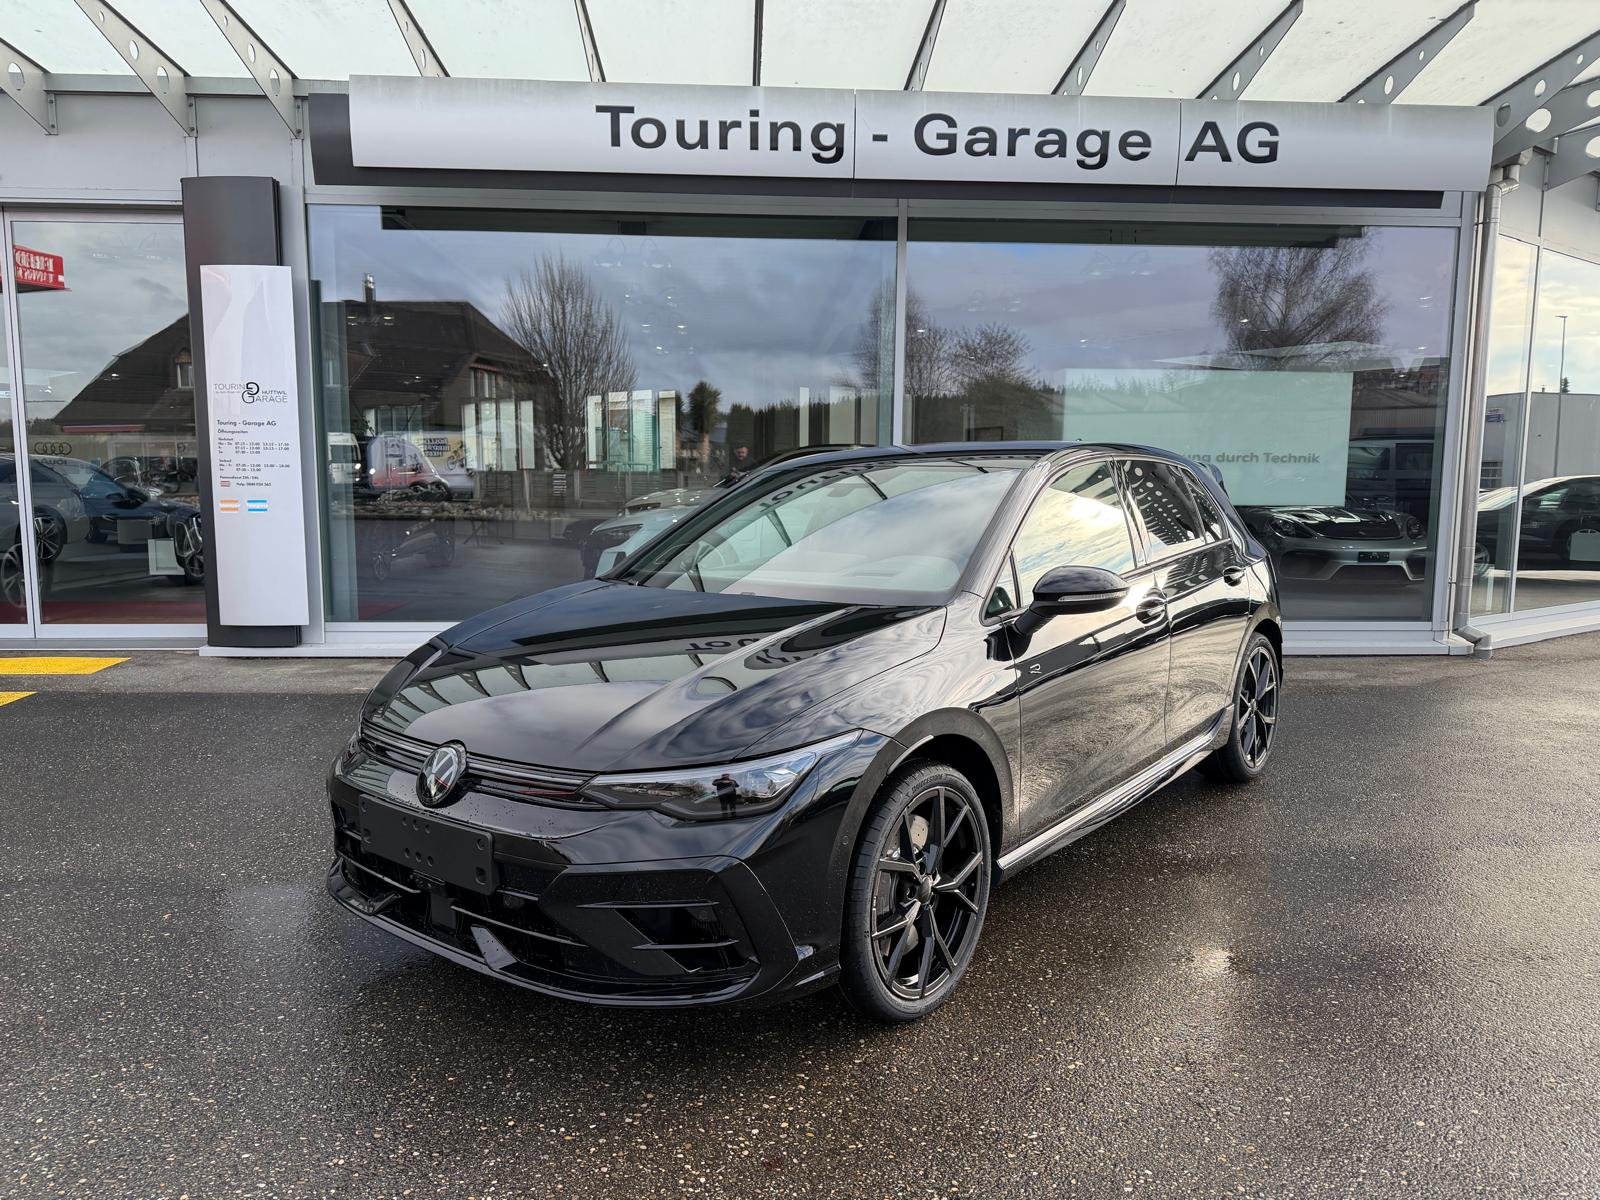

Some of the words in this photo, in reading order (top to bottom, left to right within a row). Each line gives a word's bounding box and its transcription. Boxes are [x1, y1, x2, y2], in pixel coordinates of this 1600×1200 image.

[595, 105, 845, 164] Touring
[914, 113, 1152, 170] Garage
[1184, 121, 1280, 163] AG
[1216, 453, 1259, 463] durch
[1263, 453, 1320, 463] Technik
